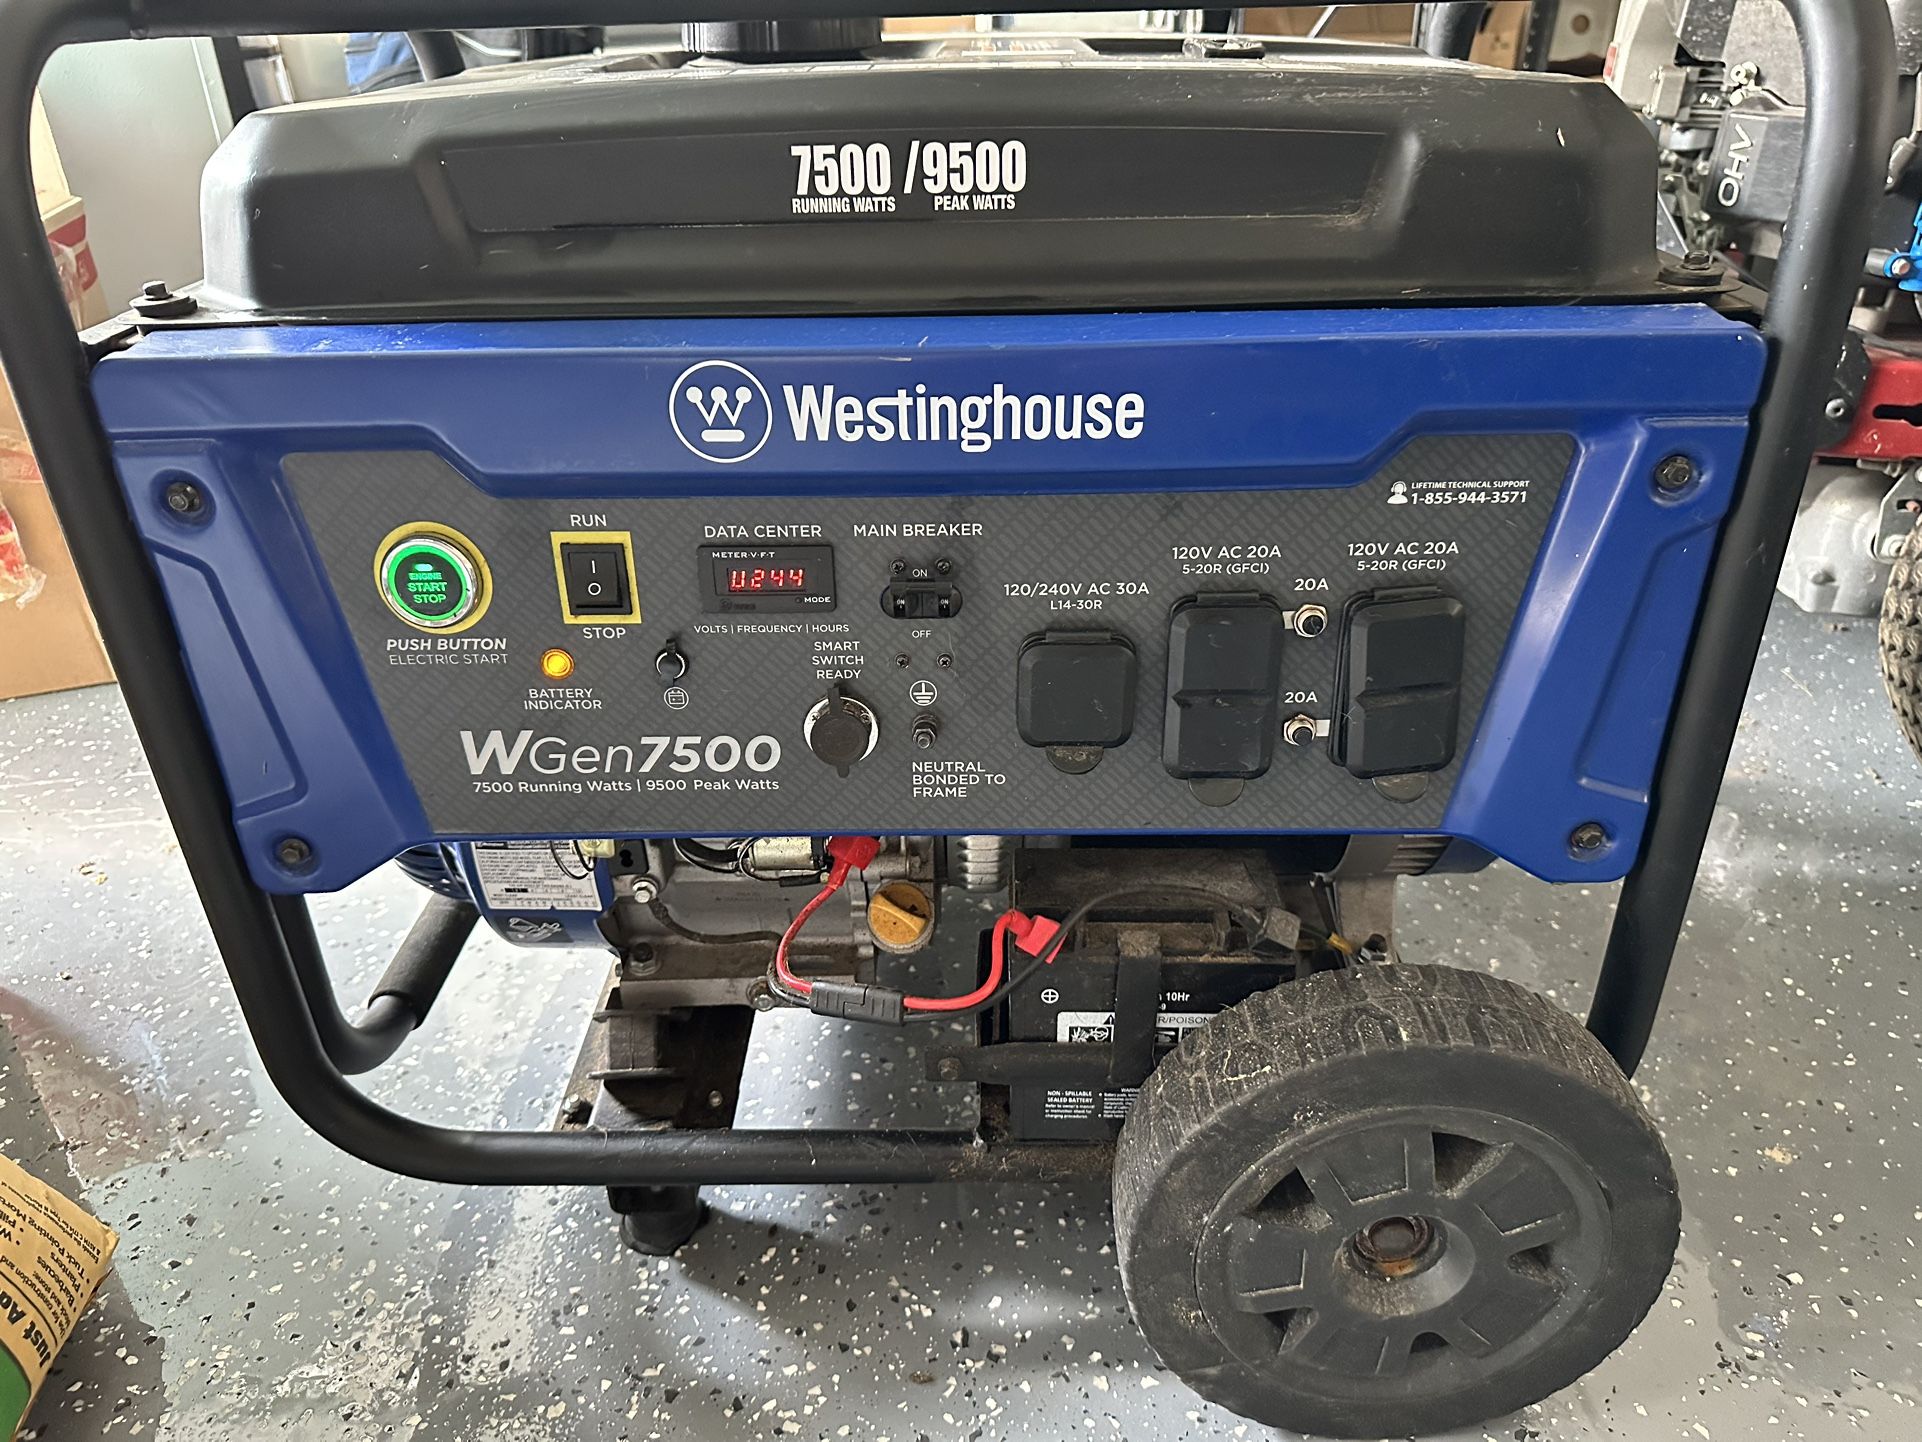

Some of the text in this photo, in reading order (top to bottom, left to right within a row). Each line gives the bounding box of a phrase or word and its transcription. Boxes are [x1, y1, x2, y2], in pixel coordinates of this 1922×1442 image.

[790, 143, 891, 196] 7500
[1718, 123, 1753, 207] OHV
[791, 196, 896, 214] RUNNING WATTS
[933, 194, 1016, 212] PEAK WATTS
[782, 383, 1145, 453] Westinghouse
[1411, 480, 1530, 489] LIFETIME TECHNICAL SUPPORT
[1411, 490, 1527, 504] 1-855-944-3571
[570, 514, 607, 527] RUN
[704, 525, 822, 538] DATA CENTER
[853, 523, 983, 537] MAIN BREAKER
[1172, 544, 1282, 560] 120V AC 20A
[1347, 541, 1460, 556] 120V AC 20A
[1182, 562, 1270, 575] 5-20R (GFCI)
[1356, 558, 1447, 572] 5-20R (GFCI)
[408, 572, 443, 580] ENGINE
[912, 568, 928, 578] ON
[407, 582, 448, 592] START
[1003, 581, 1150, 598] 120/240V AC 30A
[1294, 578, 1330, 591] 20A
[413, 594, 447, 604] STOP
[1050, 600, 1103, 610] L14-30R
[582, 627, 627, 640] STOP
[694, 625, 728, 634] VOLTS
[737, 624, 802, 634] FREQUENCY
[812, 624, 850, 633] HOURS
[912, 630, 932, 639] OFF
[386, 638, 507, 651] PUSH BUTTON
[814, 641, 860, 651] SMART
[389, 652, 509, 666] ELECTRIC START
[812, 655, 864, 666] SWITCH
[816, 669, 861, 680] READY
[528, 688, 593, 699] BATTERY
[1284, 692, 1319, 704] 20A
[524, 699, 602, 710] INDICATOR
[459, 730, 782, 775] WGen7500
[912, 761, 986, 773] NEUTRAL
[472, 781, 513, 793] 7500
[518, 780, 583, 794] Running
[586, 780, 632, 792] Watts
[645, 779, 687, 791] 9500
[693, 778, 731, 790] Peak
[735, 778, 780, 790] Watts
[912, 773, 1006, 786] BONDED TO
[912, 786, 968, 798] FRAME
[1166, 992, 1190, 1002] 10Hr
[28, 1216, 66, 1256] Pointing
[50, 1252, 82, 1293] Planters
[66, 1252, 85, 1280] Tuck
[36, 1256, 76, 1308] Barbecues
[15, 1268, 53, 1310] construction
[23, 1320, 51, 1368] Just
